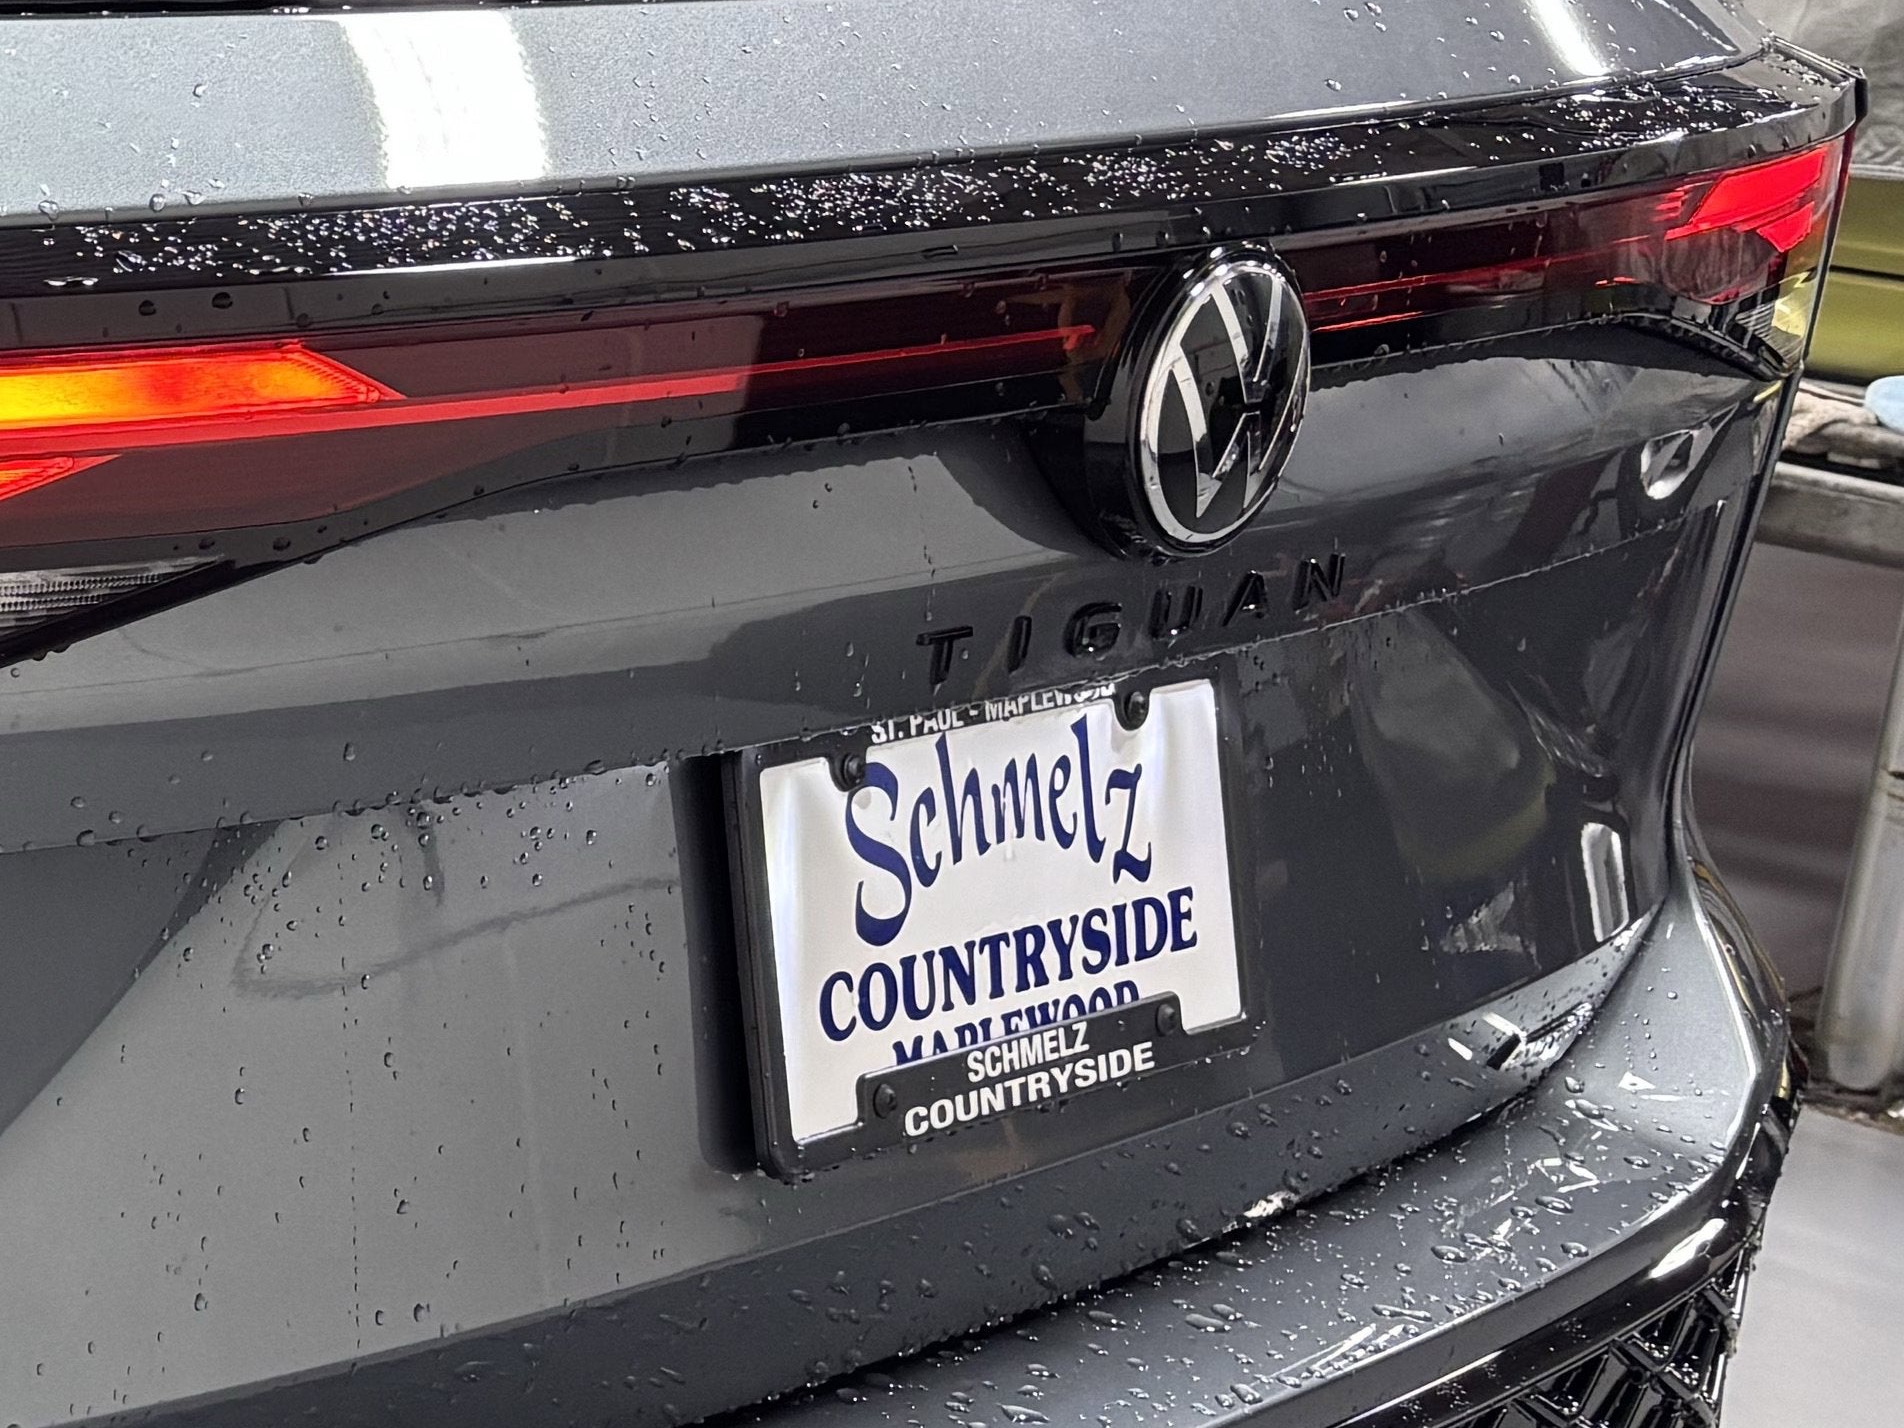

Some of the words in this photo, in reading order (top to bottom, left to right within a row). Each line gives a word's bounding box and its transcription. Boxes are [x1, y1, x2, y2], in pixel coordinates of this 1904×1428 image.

[916, 552, 1346, 685] TIGUAN
[909, 708, 964, 736] PAUL
[844, 715, 1153, 947] Schmelz
[818, 886, 1198, 1042] COUNTRYSIDE
[903, 1041, 1156, 1137] COUNTRYSIDE
[966, 1020, 1090, 1084] SCHMELZ
